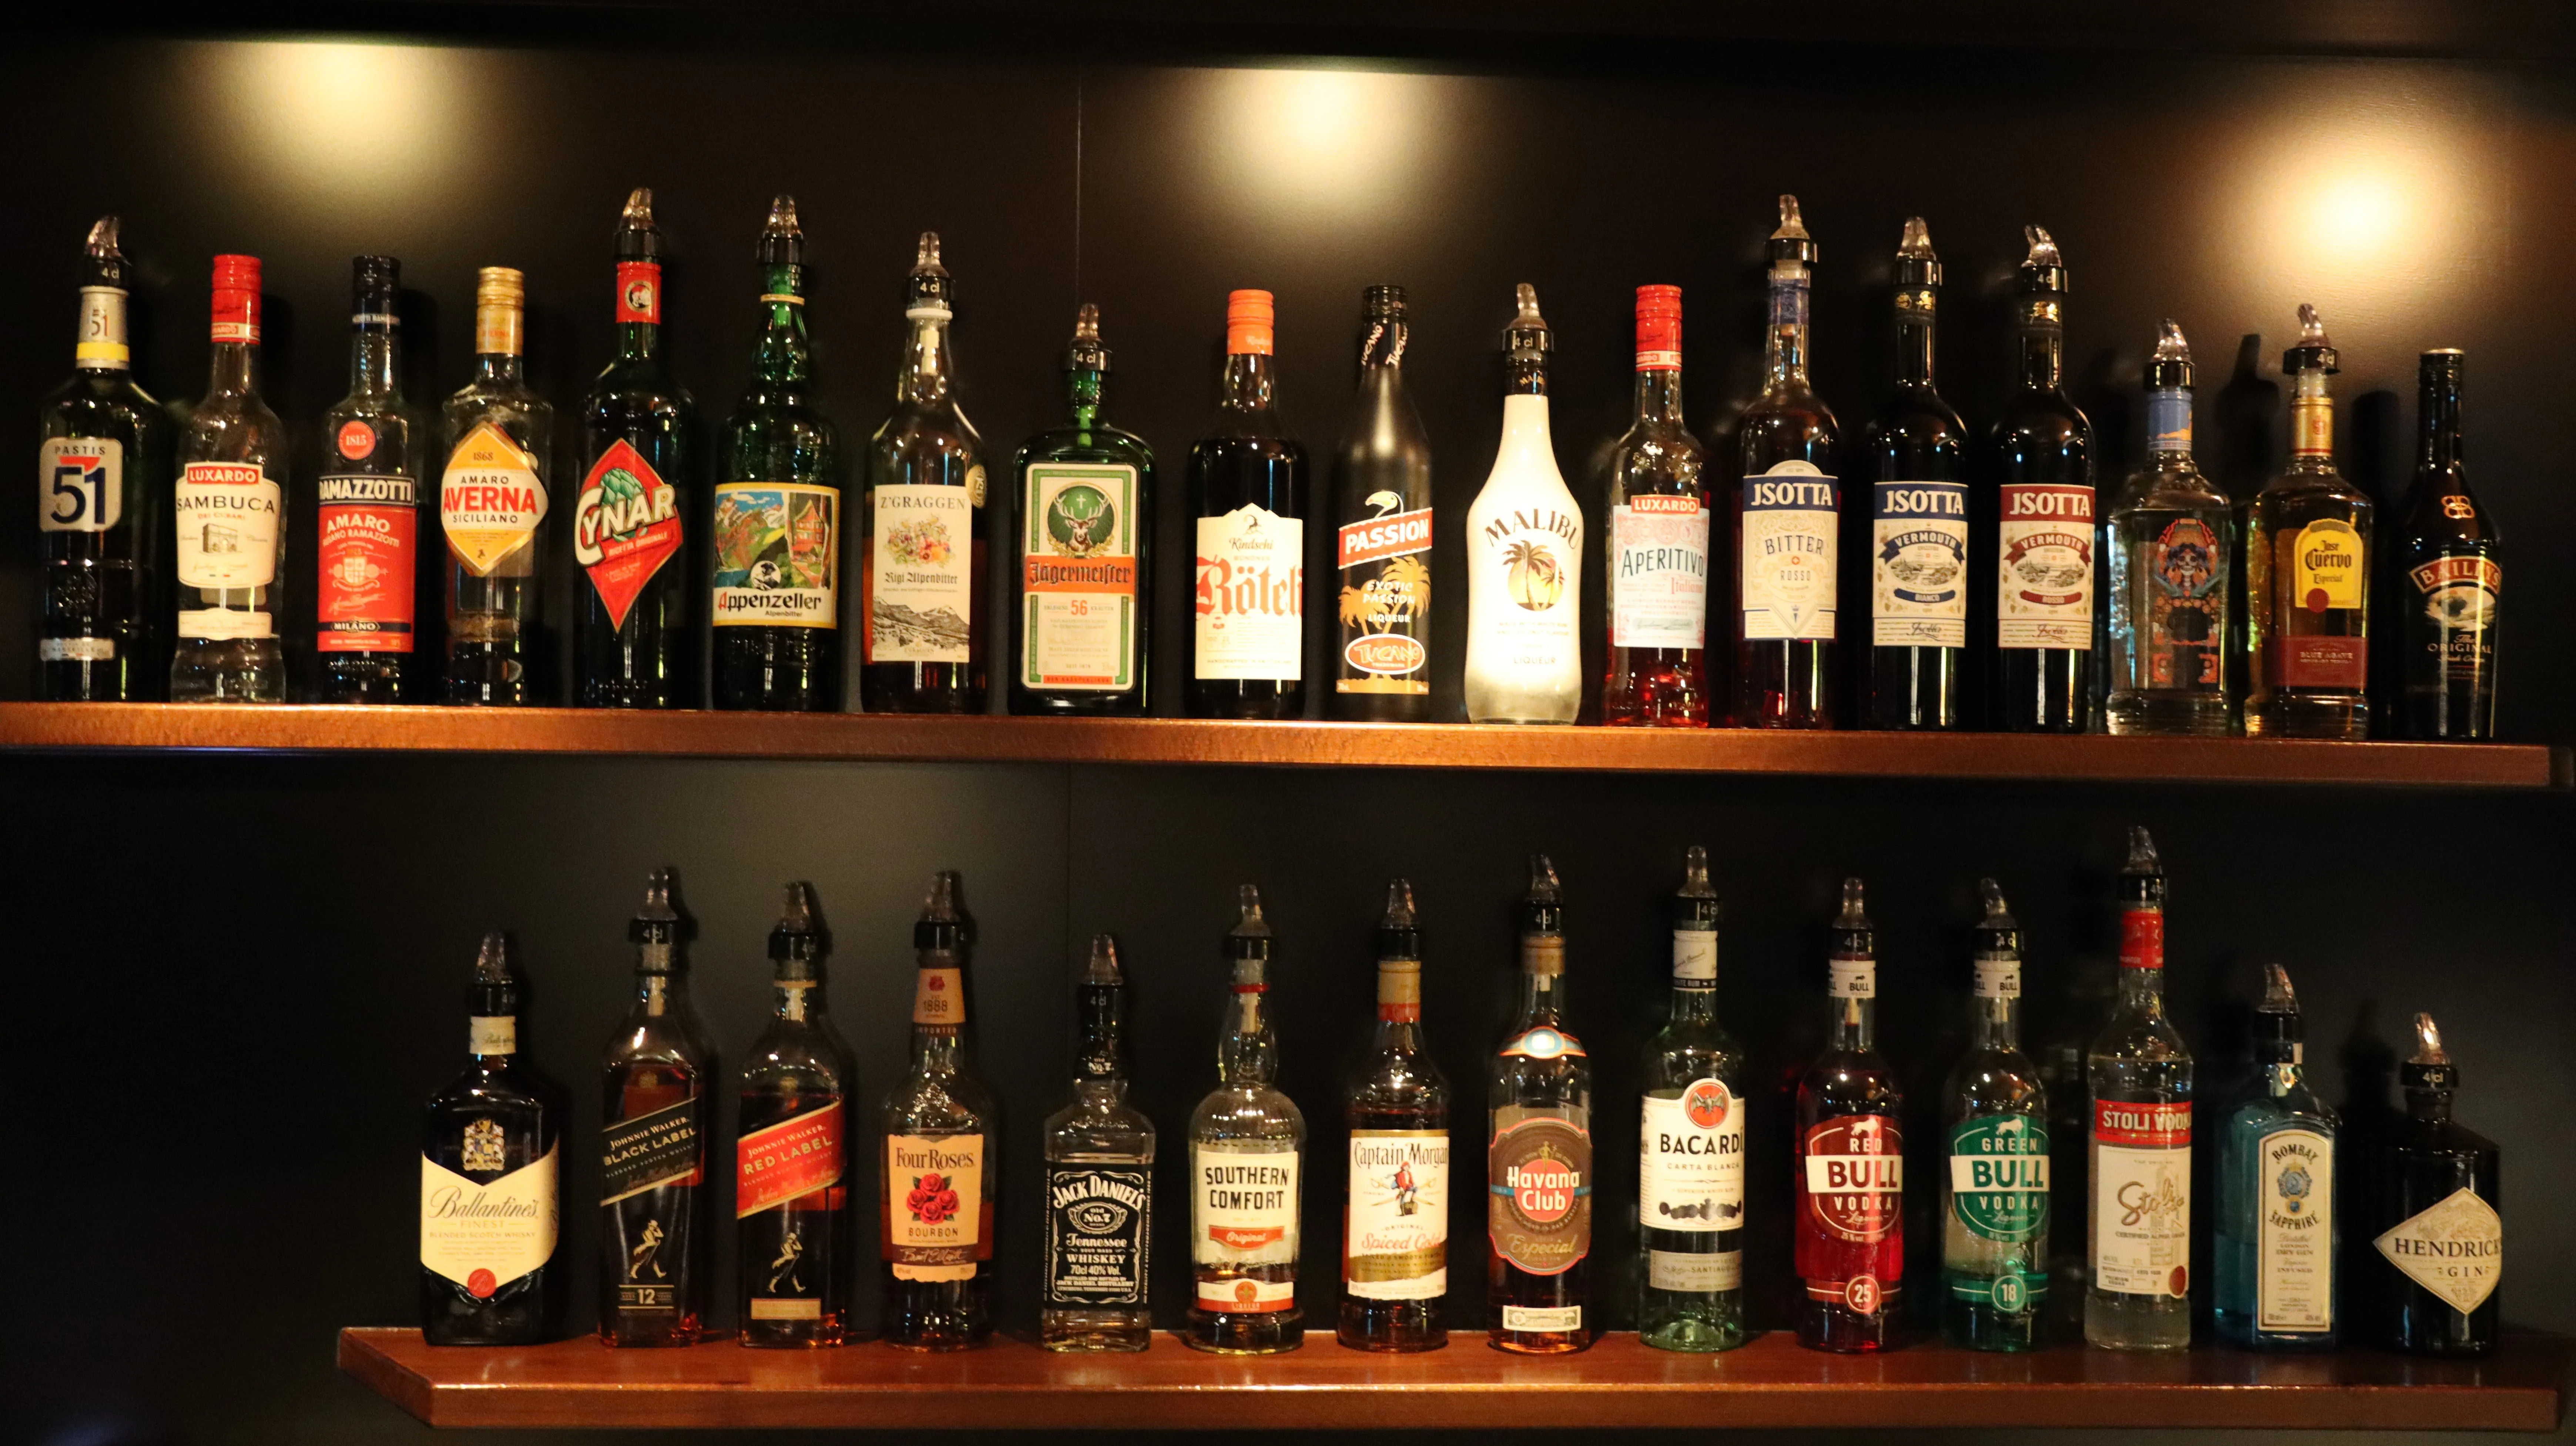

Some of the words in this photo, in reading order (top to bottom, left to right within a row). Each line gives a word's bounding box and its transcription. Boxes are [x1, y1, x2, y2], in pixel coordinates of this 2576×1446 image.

[101, 268, 108, 278] 4
[2037, 274, 2044, 283] 4
[920, 282, 927, 292] 4
[930, 282, 940, 292] cl
[1385, 327, 1408, 366] TUCAN
[1077, 353, 1083, 362] 4
[1086, 353, 1096, 363] cl
[2317, 354, 2324, 362] 4
[346, 435, 366, 445] 1815
[55, 446, 105, 456] PASTIS
[474, 452, 494, 462] 1868
[189, 468, 256, 483] LUXARDO
[461, 475, 509, 485] AMARO
[51, 466, 105, 524] 51
[319, 479, 412, 501] RAMAZZOTTI
[177, 496, 275, 513] SAMBUCA
[443, 487, 537, 514] AVERNA
[1634, 499, 1697, 513] LUXARDO
[327, 513, 390, 533] AMARO
[453, 514, 519, 523] SICILIANO
[575, 484, 676, 566] CYNAR
[1346, 519, 1429, 554] PASSION
[1485, 508, 1581, 550] MALIBU
[1765, 535, 1824, 555] BITTER
[1894, 532, 1957, 548] VERMOUTH
[2020, 534, 2083, 551] VERMOUTH
[2321, 540, 2340, 552] Jose
[1621, 548, 1703, 578] APERITIVO
[2305, 548, 2351, 571] Cuervo
[908, 572, 958, 584] Alpenbitter
[1780, 570, 1811, 581] ROSSO
[2419, 560, 2500, 586] BAILEYS
[1366, 581, 1413, 591] EXOTIC
[718, 591, 822, 612] Appenzeller
[1363, 594, 1416, 604] PASSION
[1071, 600, 1087, 615] 56
[334, 622, 376, 630] MILANO
[1368, 614, 1411, 623] LIQUEUR
[1354, 643, 1420, 664] TUCANO
[2427, 643, 2491, 654] ORIGINAL
[1849, 983, 1869, 991] BULL
[2000, 982, 2017, 991] BULL
[923, 1000, 948, 1013] 1888
[2422, 1072, 2430, 1082] 4
[2103, 1111, 2149, 1130] STOLI
[2154, 1111, 2191, 1132] VODK
[610, 1130, 650, 1151] JOHNNIE
[650, 1117, 687, 1134] WALKER
[748, 1138, 786, 1159] JOHNNIE
[787, 1124, 824, 1142] WALKER
[603, 1143, 650, 1166] BLACK
[652, 1128, 696, 1149] LABEL
[1850, 1138, 1883, 1152] RED
[1982, 1138, 2037, 1152] GREEN
[2271, 1144, 2319, 1161] BOMBAY
[744, 1156, 776, 1175] RED
[780, 1135, 832, 1162] LABEL
[896, 1148, 926, 1167] Four
[928, 1149, 974, 1170] Roses
[1354, 1142, 1404, 1169] Captain
[1205, 1166, 1289, 1186] SOUTHERN
[1506, 1166, 1580, 1189] Havana
[1827, 1160, 1898, 1188] BULL
[1971, 1160, 2044, 1188] BULL
[1053, 1181, 1090, 1209] JACK
[1090, 1175, 1146, 1211] DANIEL'S
[1210, 1190, 1284, 1210] COMFORT
[1521, 1190, 1566, 1211] Club
[428, 1185, 540, 1219] Ballantine's
[1834, 1196, 1892, 1211] VODKA
[1980, 1196, 2039, 1210] VODKA
[2269, 1213, 2320, 1230] SAPPHIRE
[908, 1227, 958, 1237] BOURBON
[1226, 1231, 1267, 1245] Original
[1066, 1233, 1127, 1248] Tennessee
[1362, 1233, 1412, 1251] Spiced
[1507, 1233, 1578, 1260] Especial
[1066, 1254, 1126, 1264] WHISKEY
[1070, 1264, 1087, 1275] 70cl
[1088, 1265, 1106, 1275] 40%
[2448, 1266, 2483, 1277] GIN
[637, 1289, 655, 1304] 12
[1854, 1285, 1872, 1303] 25
[2002, 1284, 2017, 1302] 18
